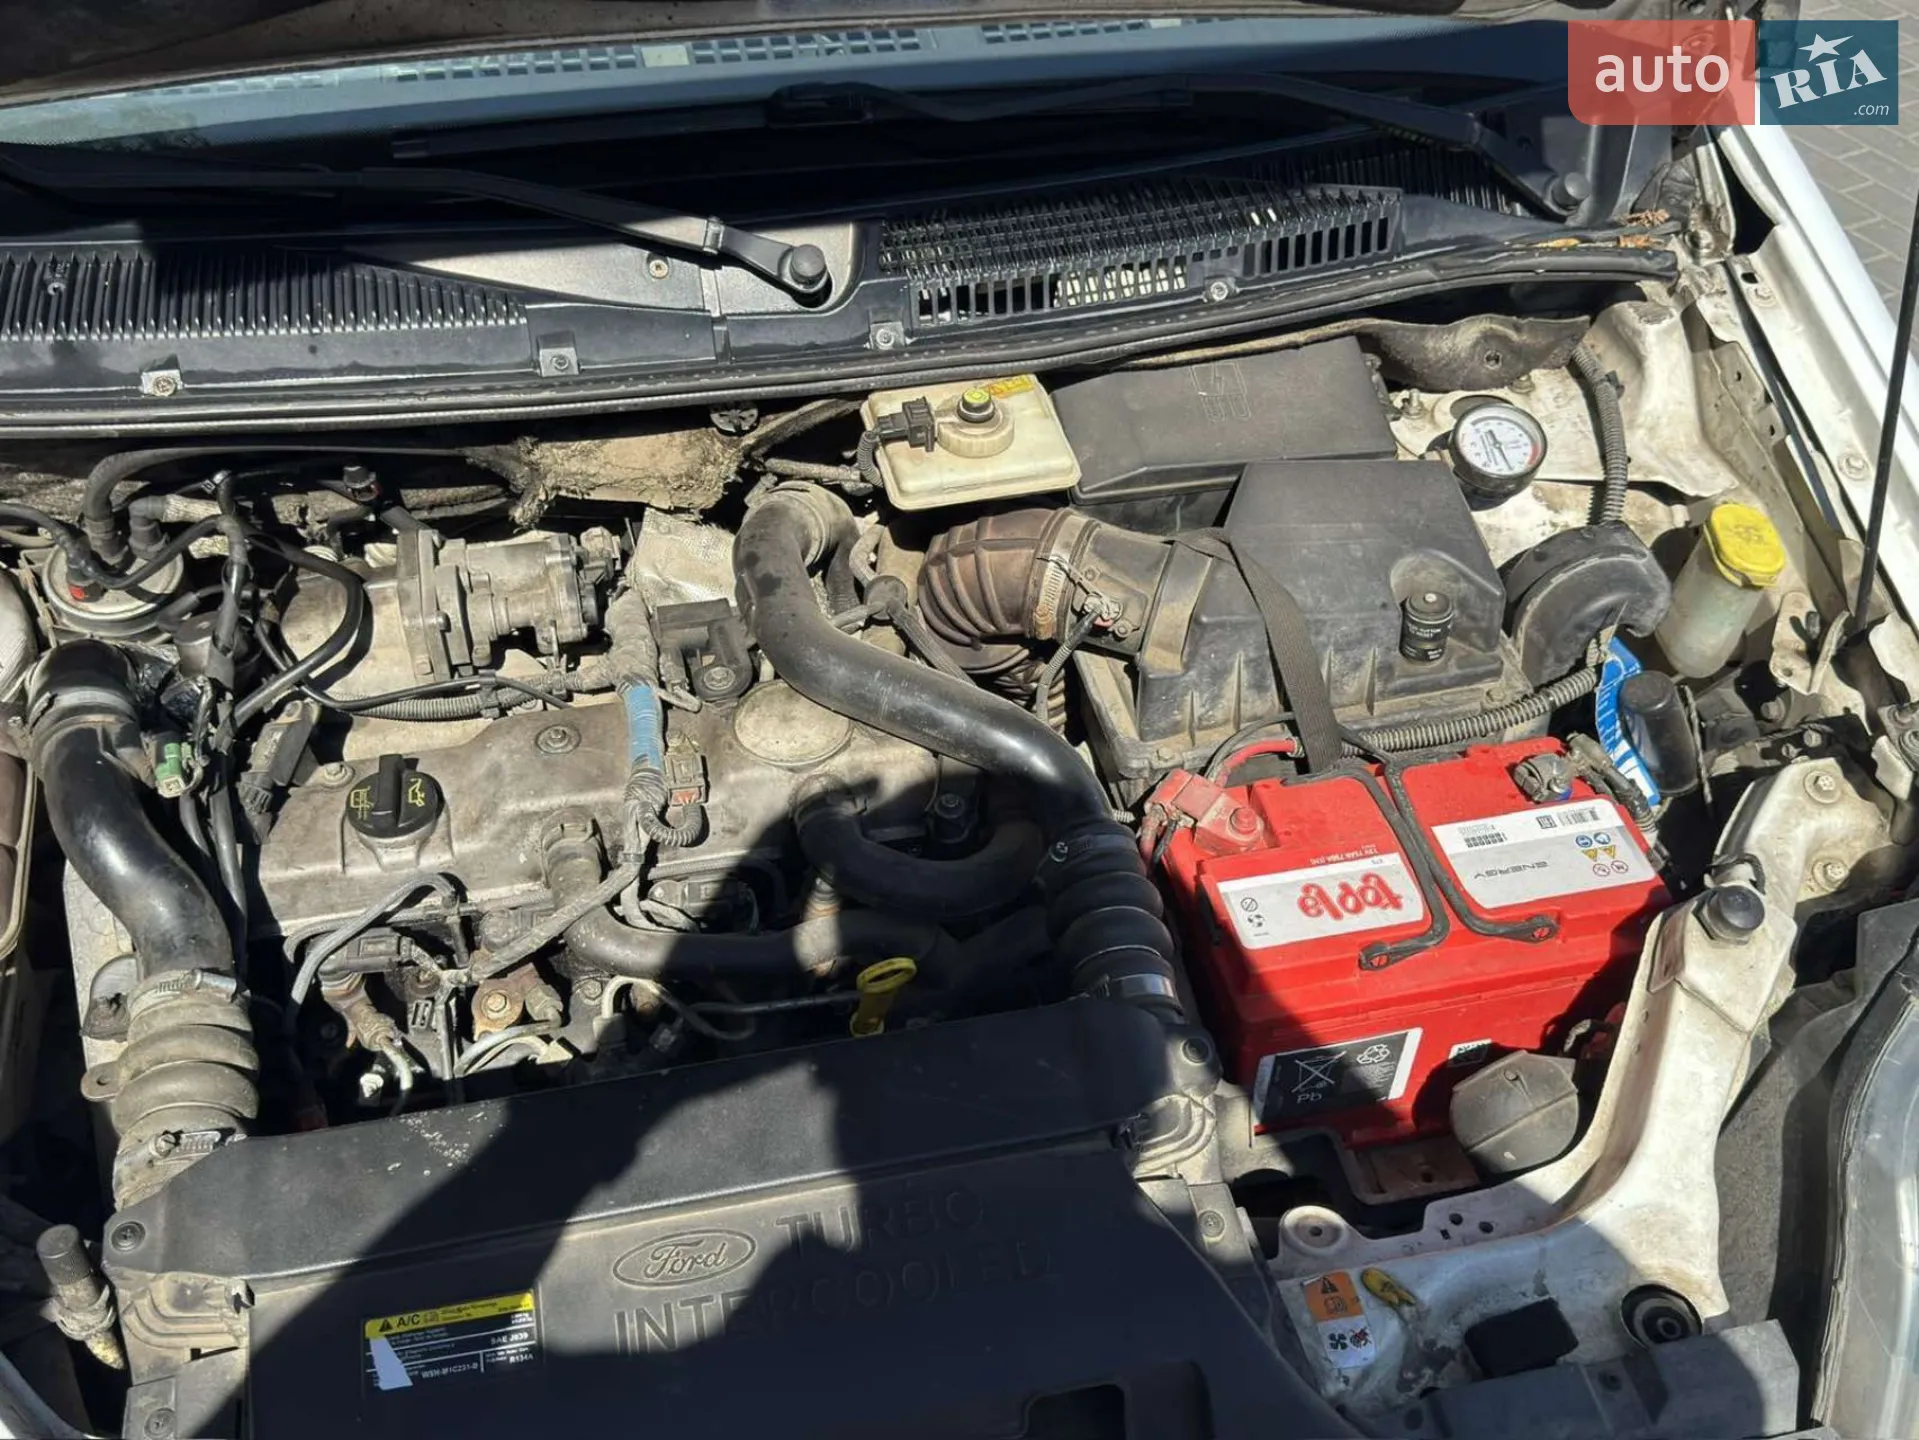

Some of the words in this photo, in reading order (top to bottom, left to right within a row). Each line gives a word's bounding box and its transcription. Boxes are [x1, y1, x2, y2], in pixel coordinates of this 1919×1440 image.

[1473, 861, 1549, 880] ENERGY
[1297, 872, 1404, 921] topla
[776, 1191, 986, 1255] TURBO
[643, 1238, 726, 1280] Ford
[396, 1313, 421, 1329] A/C
